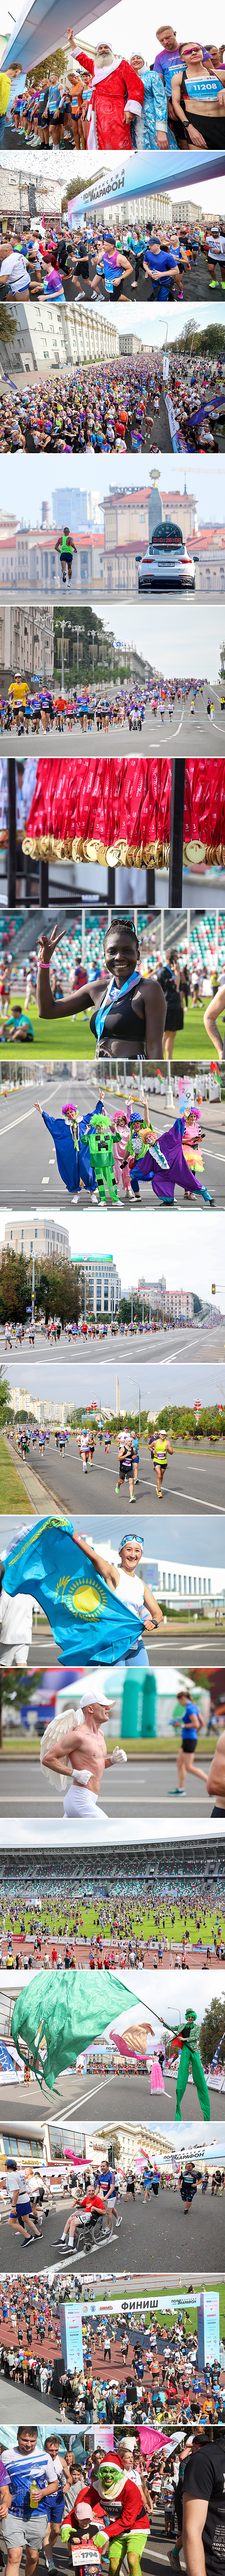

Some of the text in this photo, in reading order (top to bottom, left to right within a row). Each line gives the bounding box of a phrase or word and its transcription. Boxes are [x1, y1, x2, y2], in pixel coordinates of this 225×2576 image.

[83, 177, 125, 202] ПОЛУ МАРАФОН
[94, 169, 125, 191] МИНСКИЙ
[121, 2300, 158, 2310] ФИНИШ
